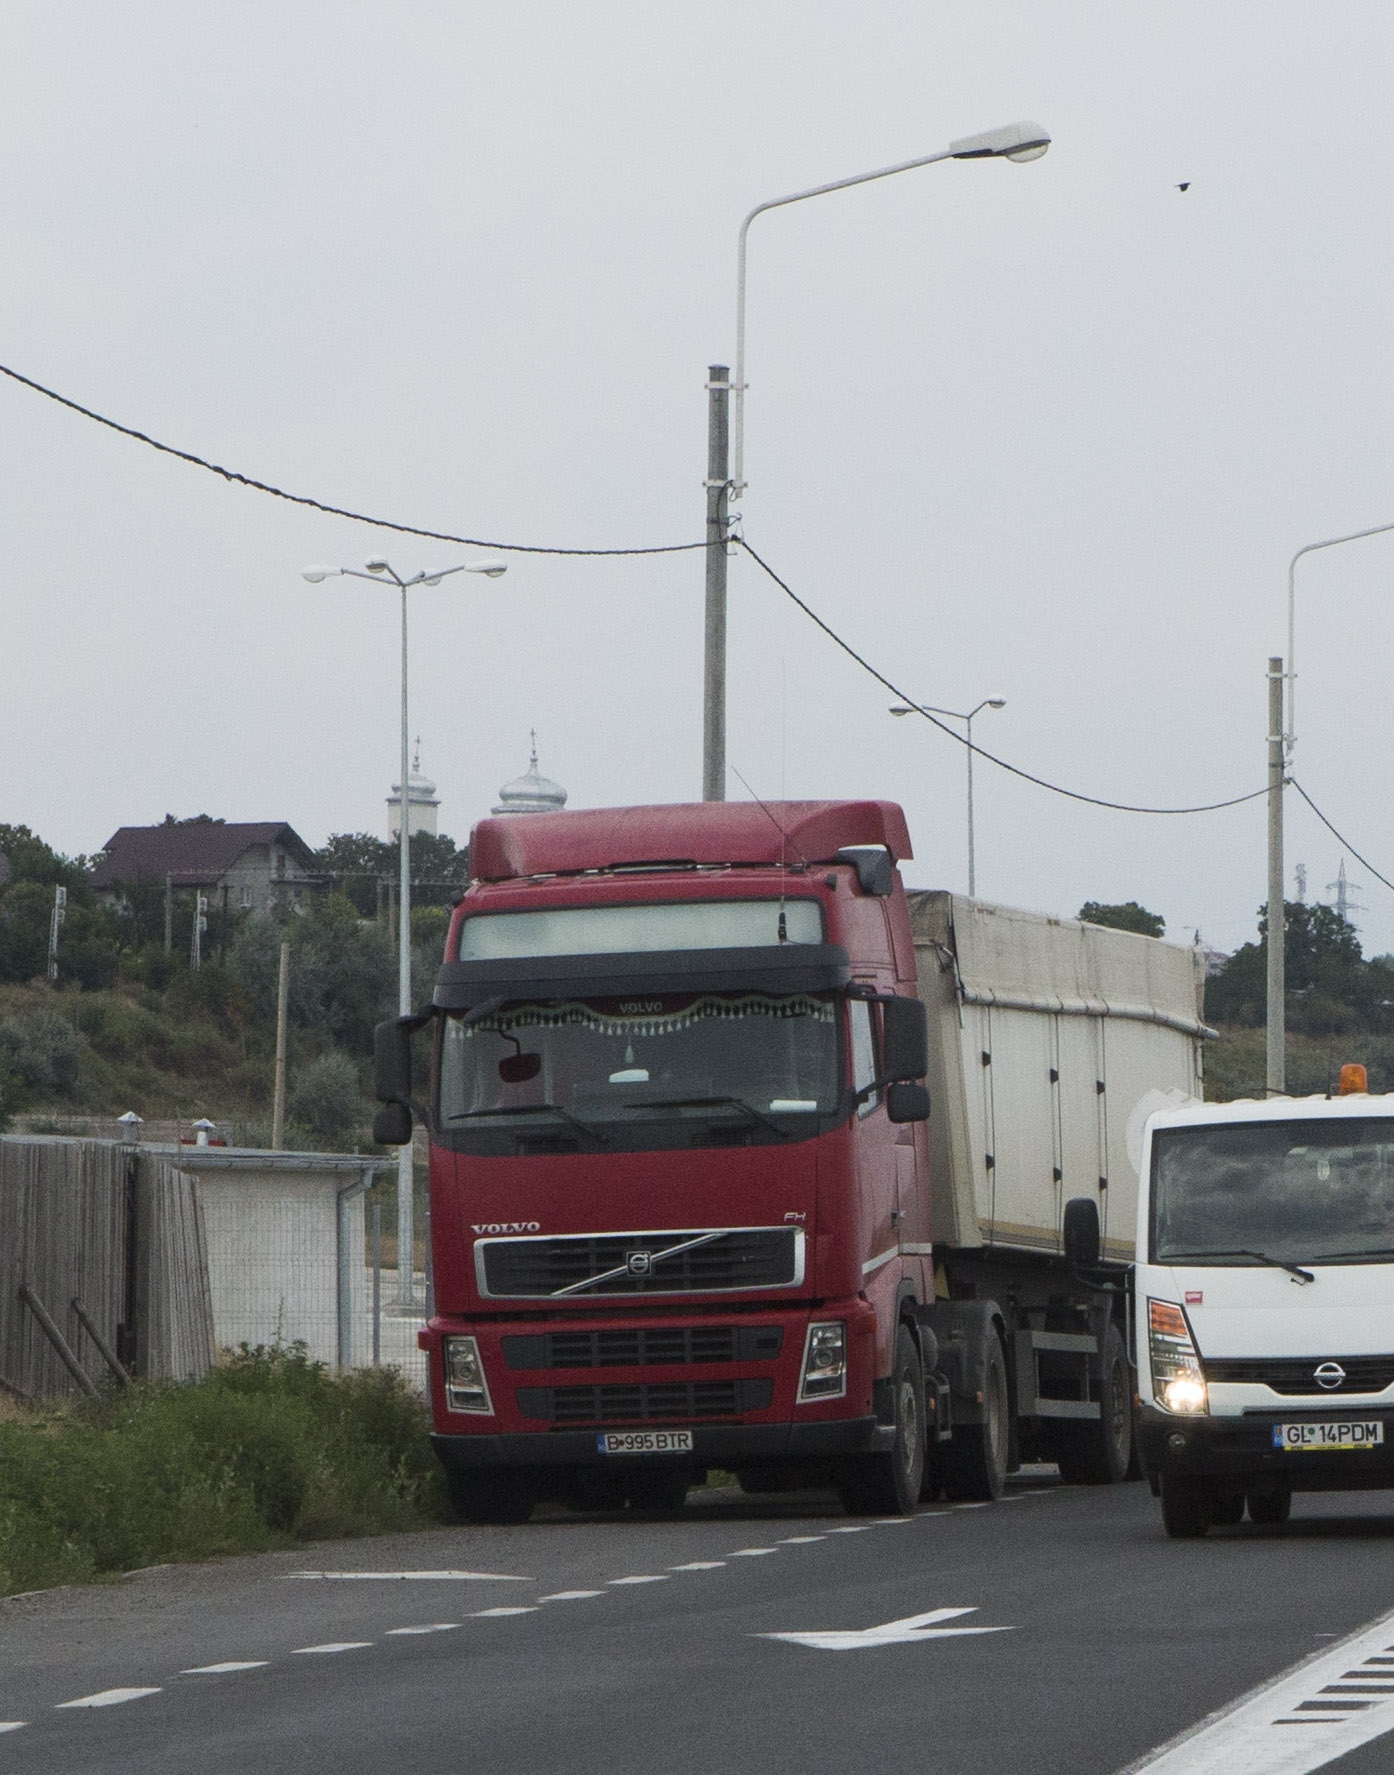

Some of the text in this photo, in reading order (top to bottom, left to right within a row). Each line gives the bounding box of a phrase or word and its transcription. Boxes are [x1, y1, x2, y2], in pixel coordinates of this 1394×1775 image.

[619, 1001, 663, 1013] VOLVO
[783, 1211, 806, 1221] FH
[470, 1221, 540, 1234] VOLVO
